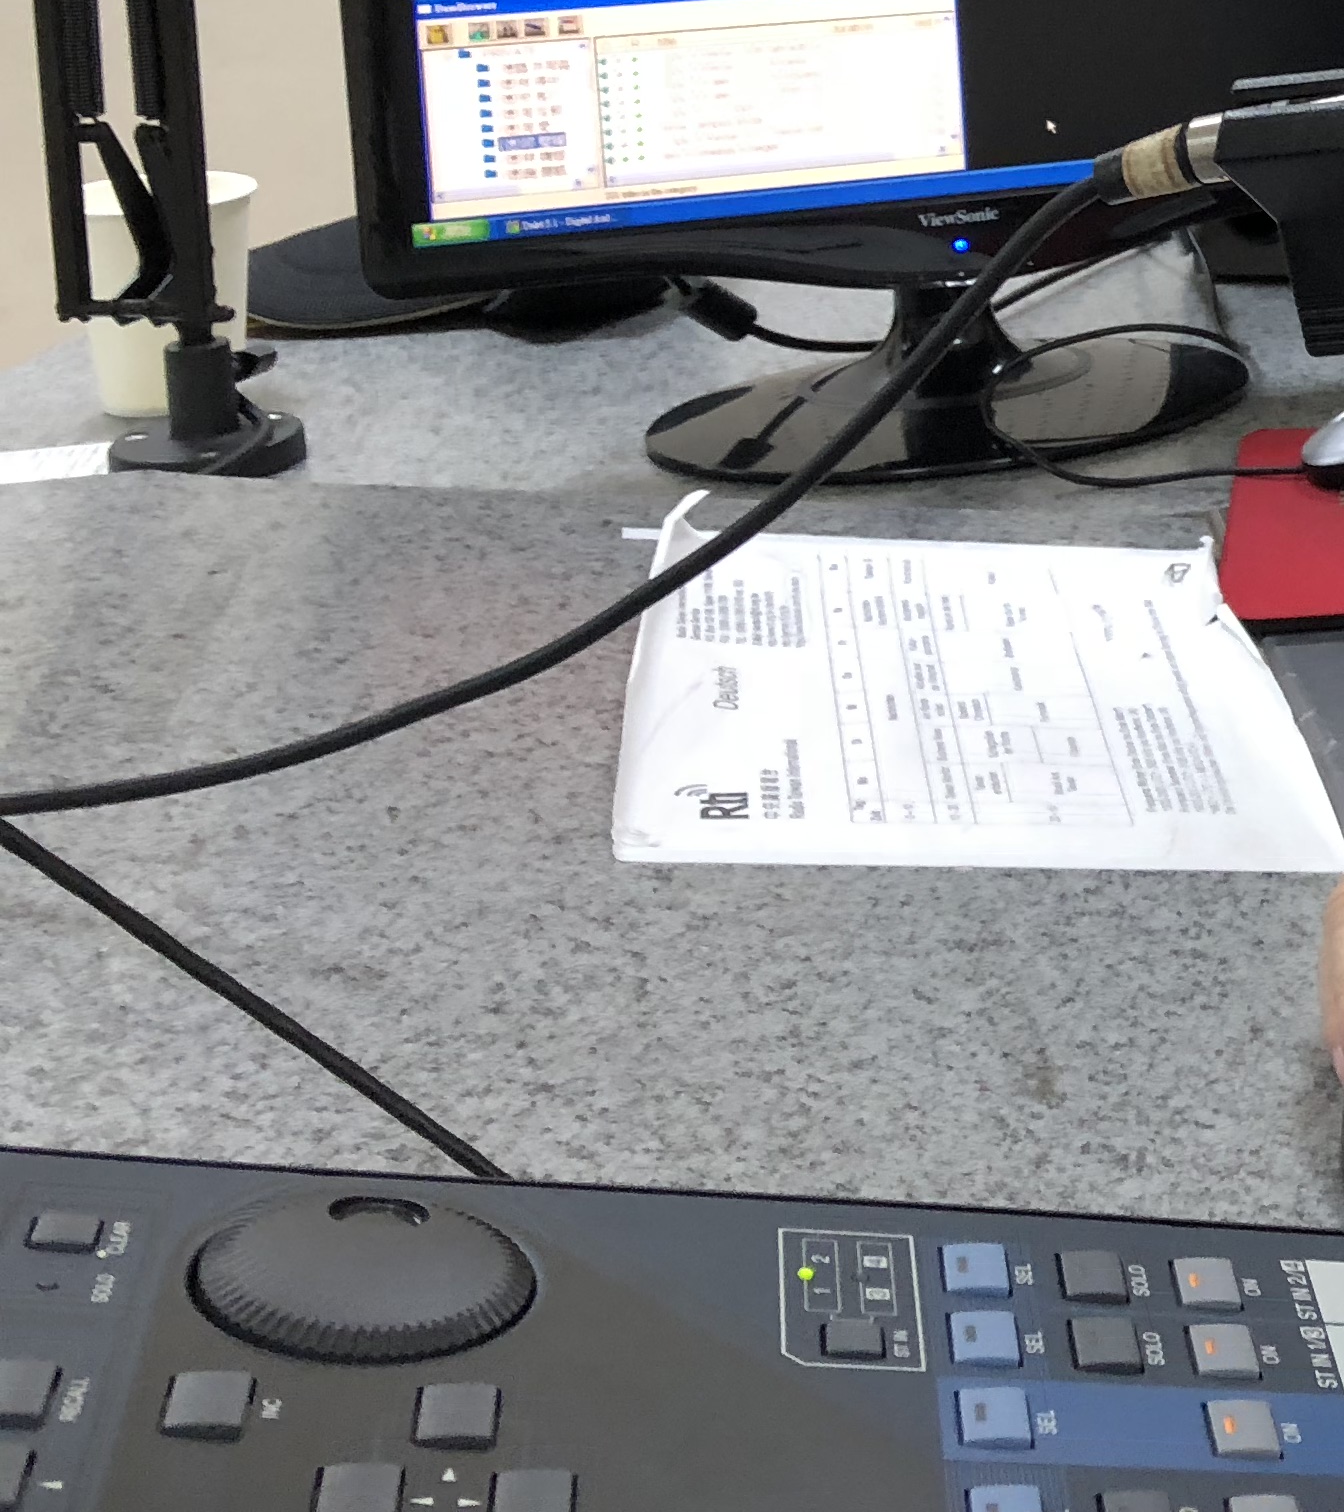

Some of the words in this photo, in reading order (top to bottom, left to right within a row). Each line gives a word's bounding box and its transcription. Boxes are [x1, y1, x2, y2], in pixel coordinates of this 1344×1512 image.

[917, 206, 1000, 227] ViewSonic
[711, 665, 739, 711] Deutsch
[1014, 1263, 1033, 1285] SEL
[1128, 1264, 1150, 1297] SOLO
[1241, 1277, 1261, 1297] ON
[1291, 1287, 1312, 1302] IN
[1295, 1302, 1317, 1321] ST
[1024, 1330, 1044, 1354] SEL
[1142, 1331, 1165, 1366] SOLO
[1259, 1344, 1280, 1365] ON
[1310, 1353, 1333, 1368] IN
[1315, 1370, 1338, 1389] ST
[1036, 1409, 1057, 1435] SEL
[1281, 1422, 1302, 1444] ON
